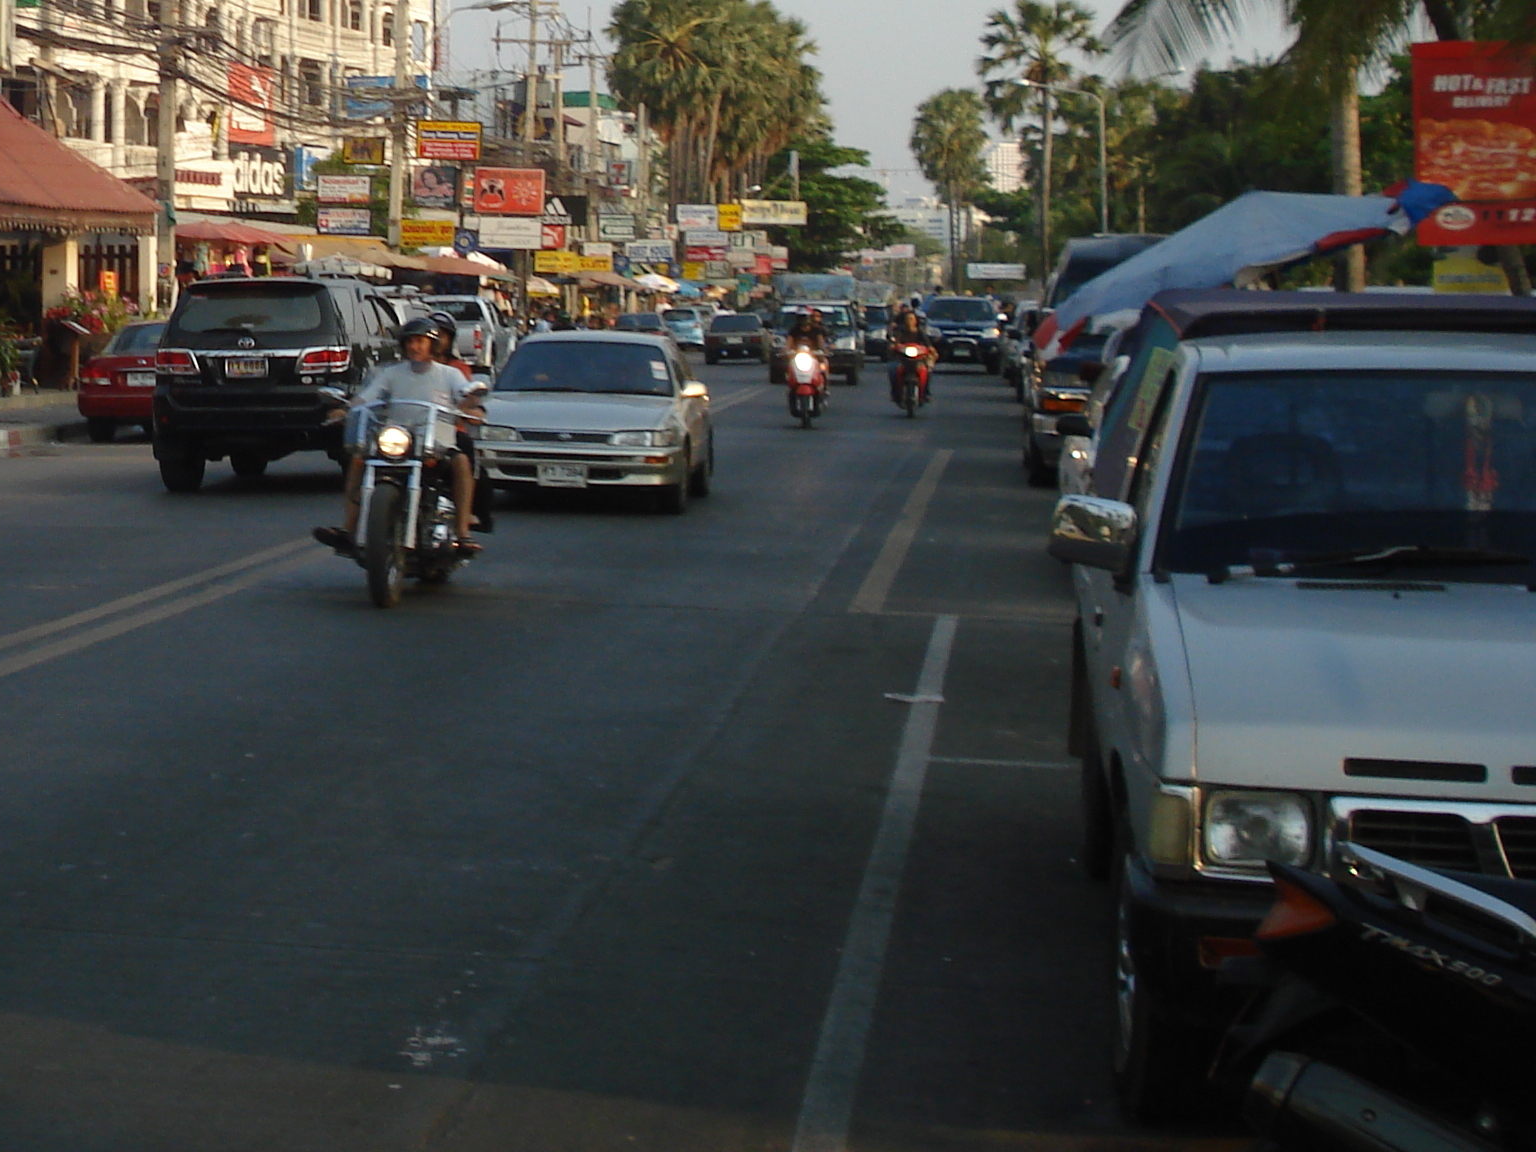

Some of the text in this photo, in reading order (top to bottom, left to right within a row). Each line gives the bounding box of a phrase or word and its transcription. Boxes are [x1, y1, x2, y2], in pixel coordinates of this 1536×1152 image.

[1433, 74, 1475, 92] HOT
[1486, 76, 1533, 94] FAST
[233, 151, 286, 196] didas
